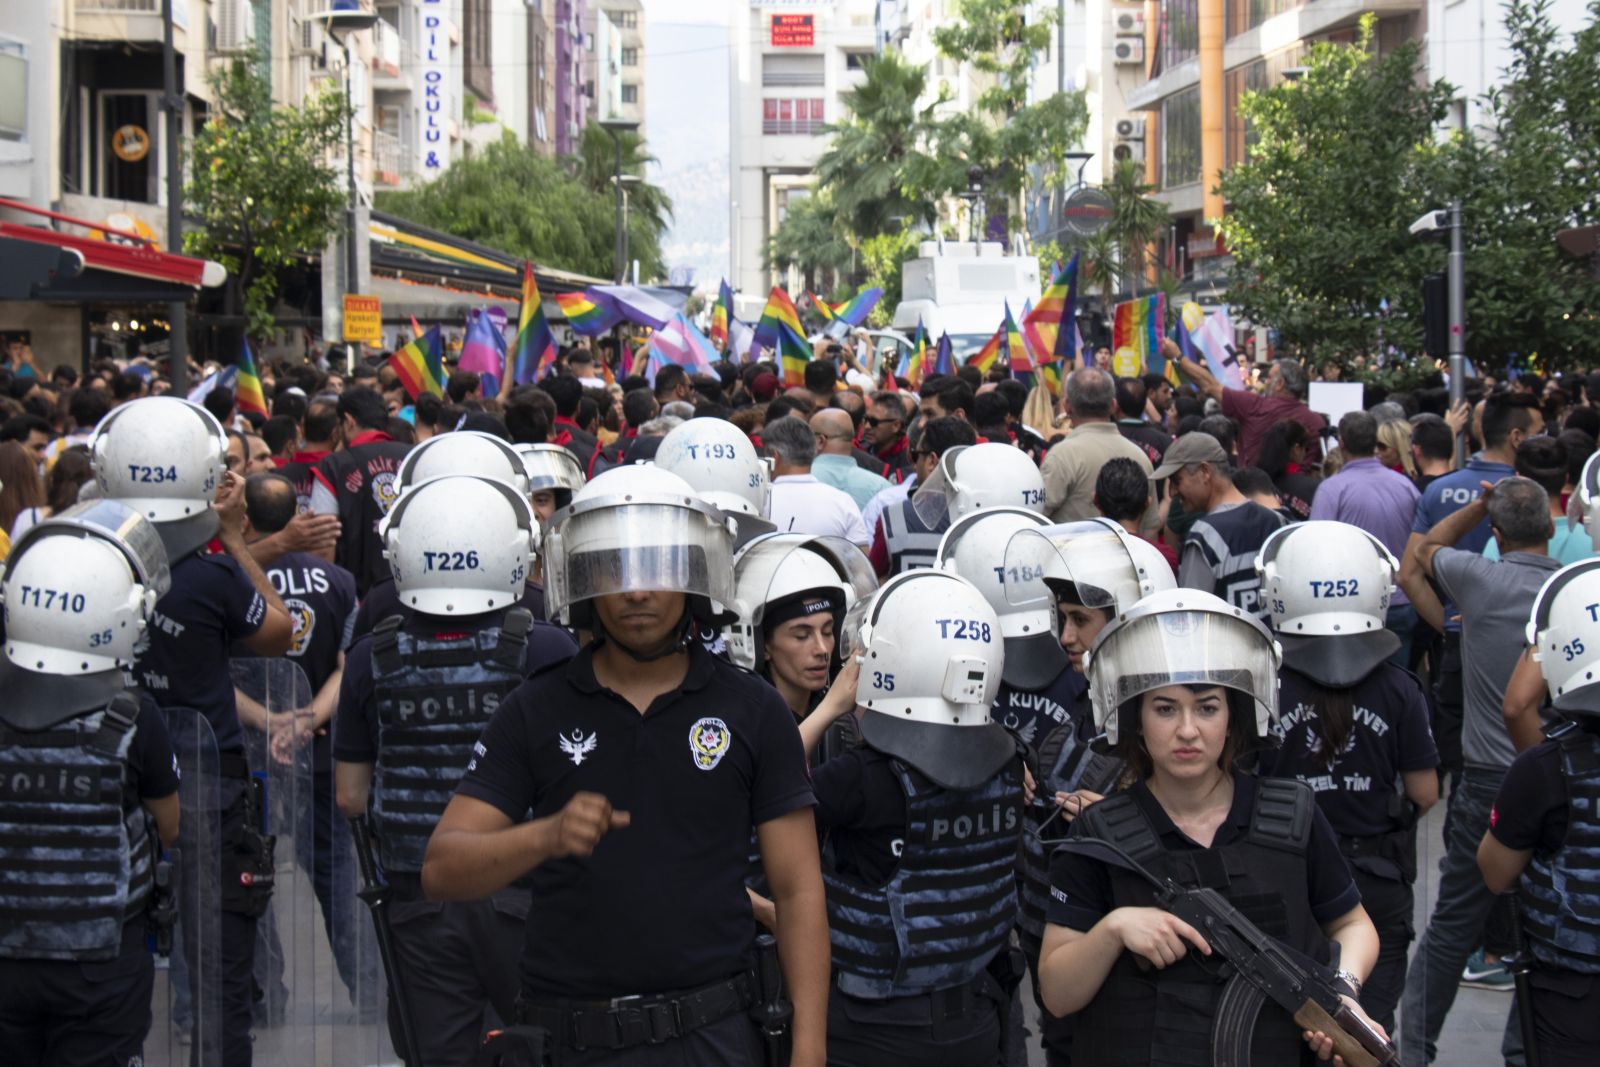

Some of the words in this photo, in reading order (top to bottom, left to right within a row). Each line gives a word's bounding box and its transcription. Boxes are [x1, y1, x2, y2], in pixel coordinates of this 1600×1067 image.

[425, 71, 441, 143] OKULU
[425, 151, 440, 169] &
[687, 443, 736, 460] T193
[128, 464, 178, 483] T234
[202, 475, 215, 493] 35
[748, 473, 761, 488] 35
[424, 550, 479, 571] T226
[266, 567, 329, 595] OLİS
[510, 564, 524, 585] 35
[21, 585, 86, 613] T1710
[1309, 579, 1359, 598] T252
[1272, 599, 1286, 614] 35
[88, 628, 113, 648] 35
[935, 618, 992, 644] T258
[1562, 637, 1585, 662] 35
[143, 670, 169, 690] TİM
[872, 671, 895, 692] 35
[1008, 692, 1071, 726] KUVVET
[1351, 704, 1389, 737] VVET
[0, 769, 91, 798] OLİS
[1296, 773, 1339, 792] ZEL
[1342, 772, 1372, 792] TİM
[931, 803, 1017, 842] POLİS
